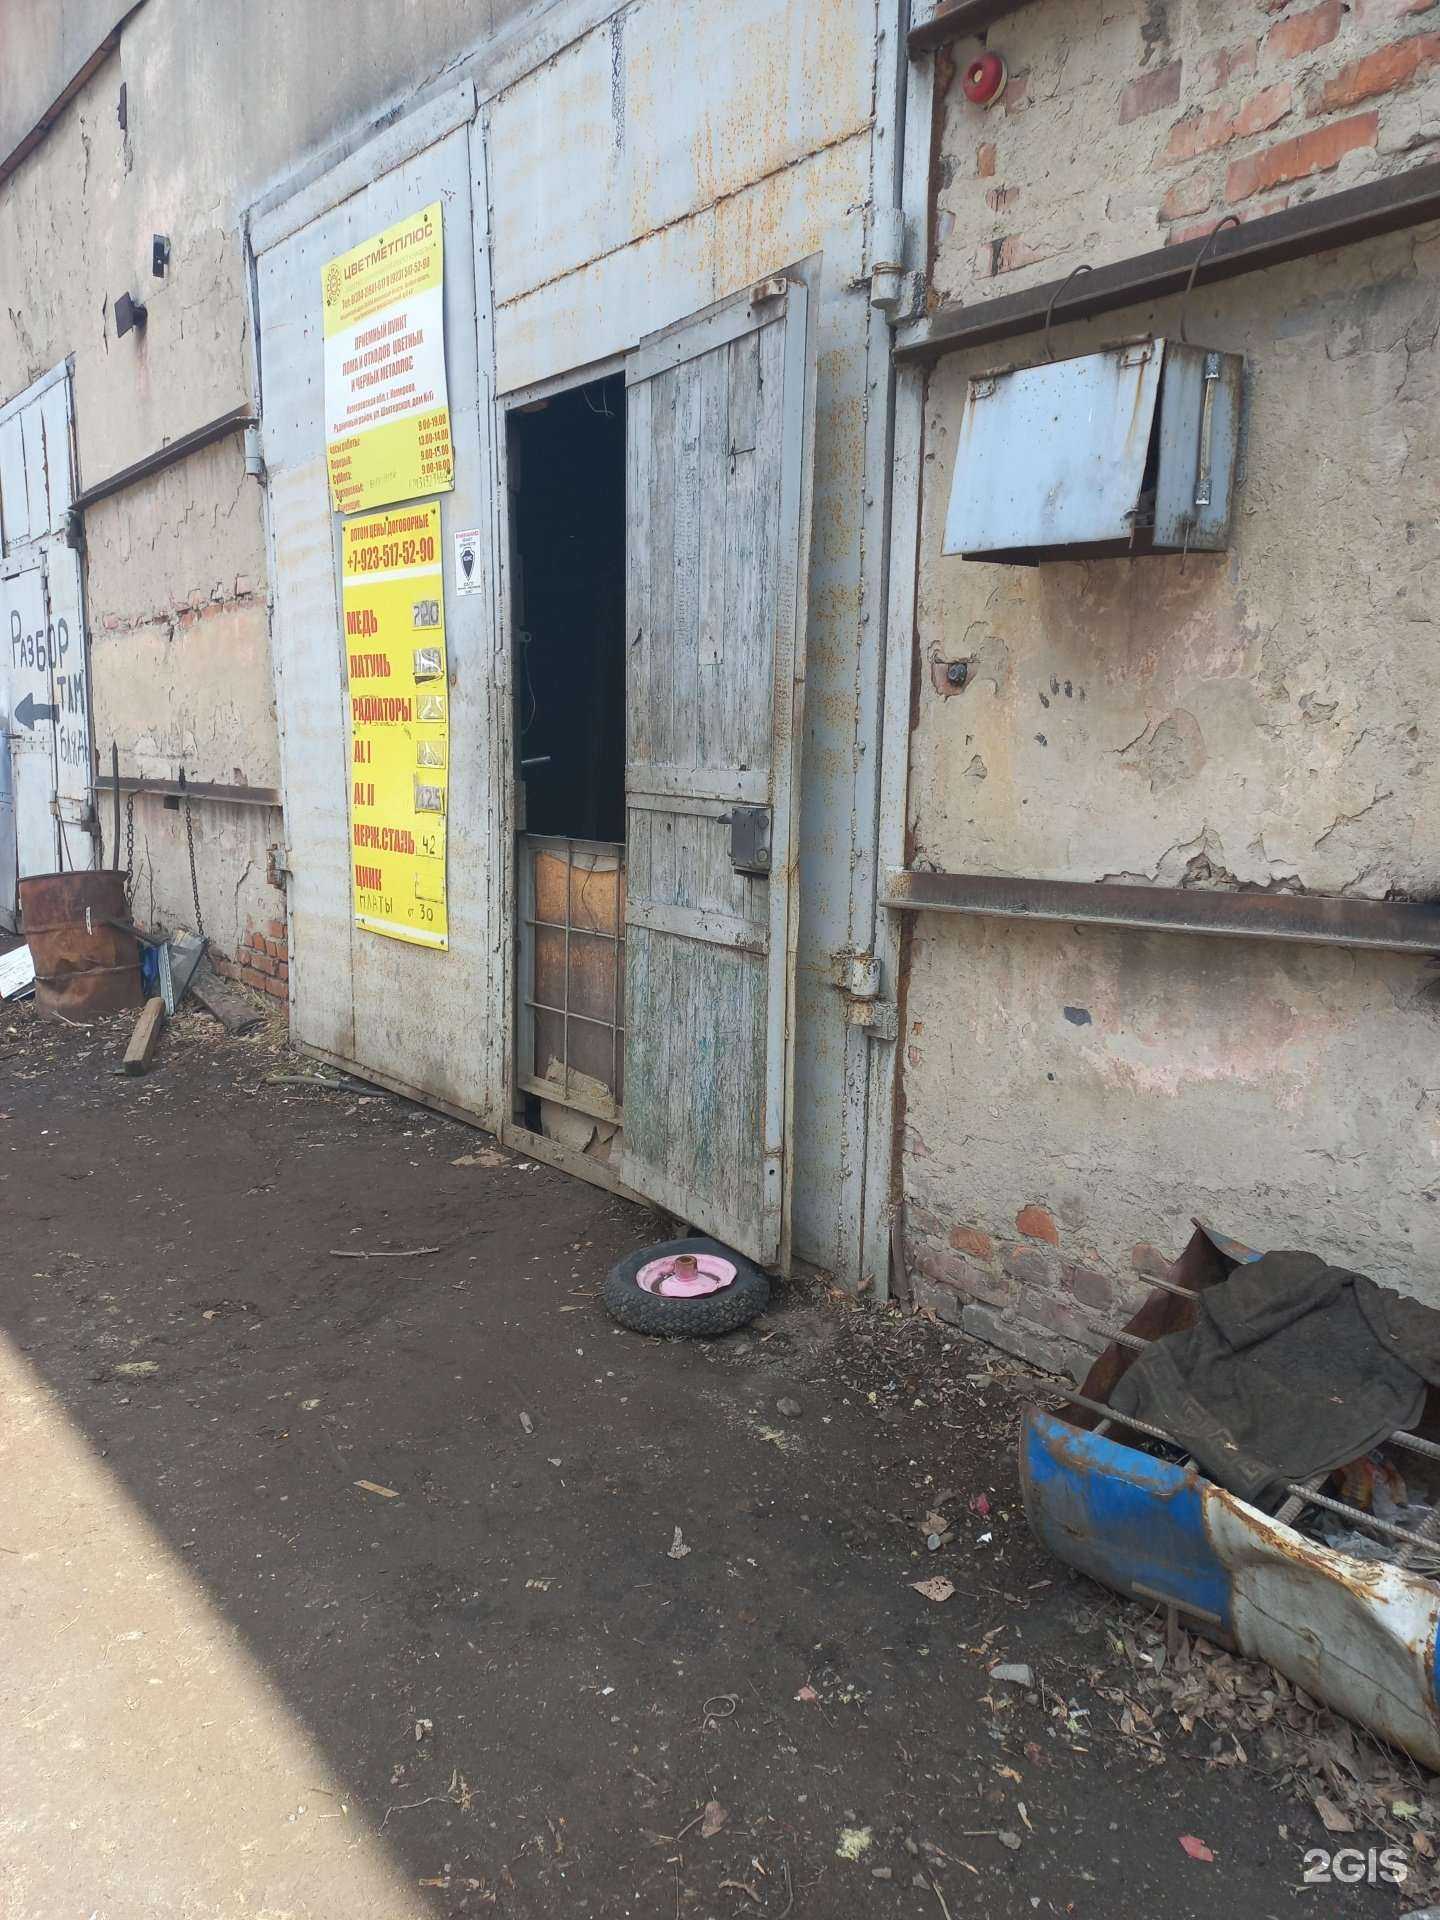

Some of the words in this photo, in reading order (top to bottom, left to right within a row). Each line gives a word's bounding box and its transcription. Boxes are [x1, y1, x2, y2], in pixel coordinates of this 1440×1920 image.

[344, 223, 433, 280] ЦВЕТМЕТПЛЮС
[387, 314, 407, 336] ПУНКТ
[392, 328, 424, 356] ЦВЕТНЫХ
[350, 525, 369, 542] ОПТОМ
[369, 521, 387, 539] ЦЕНЫ
[387, 513, 430, 537] ДОГОВОРНЫЕ
[347, 536, 434, 573] +7-923-517-52-90
[346, 609, 378, 638] МЕДЬ
[350, 653, 391, 679] ЛАТУНЬ
[352, 697, 412, 725] РАДИАТОРЫ
[353, 823, 415, 855] НЕРЖ.СТАЛЬ
[355, 864, 382, 891] ЦИНК
[359, 895, 393, 914] ПЛАТЫ
